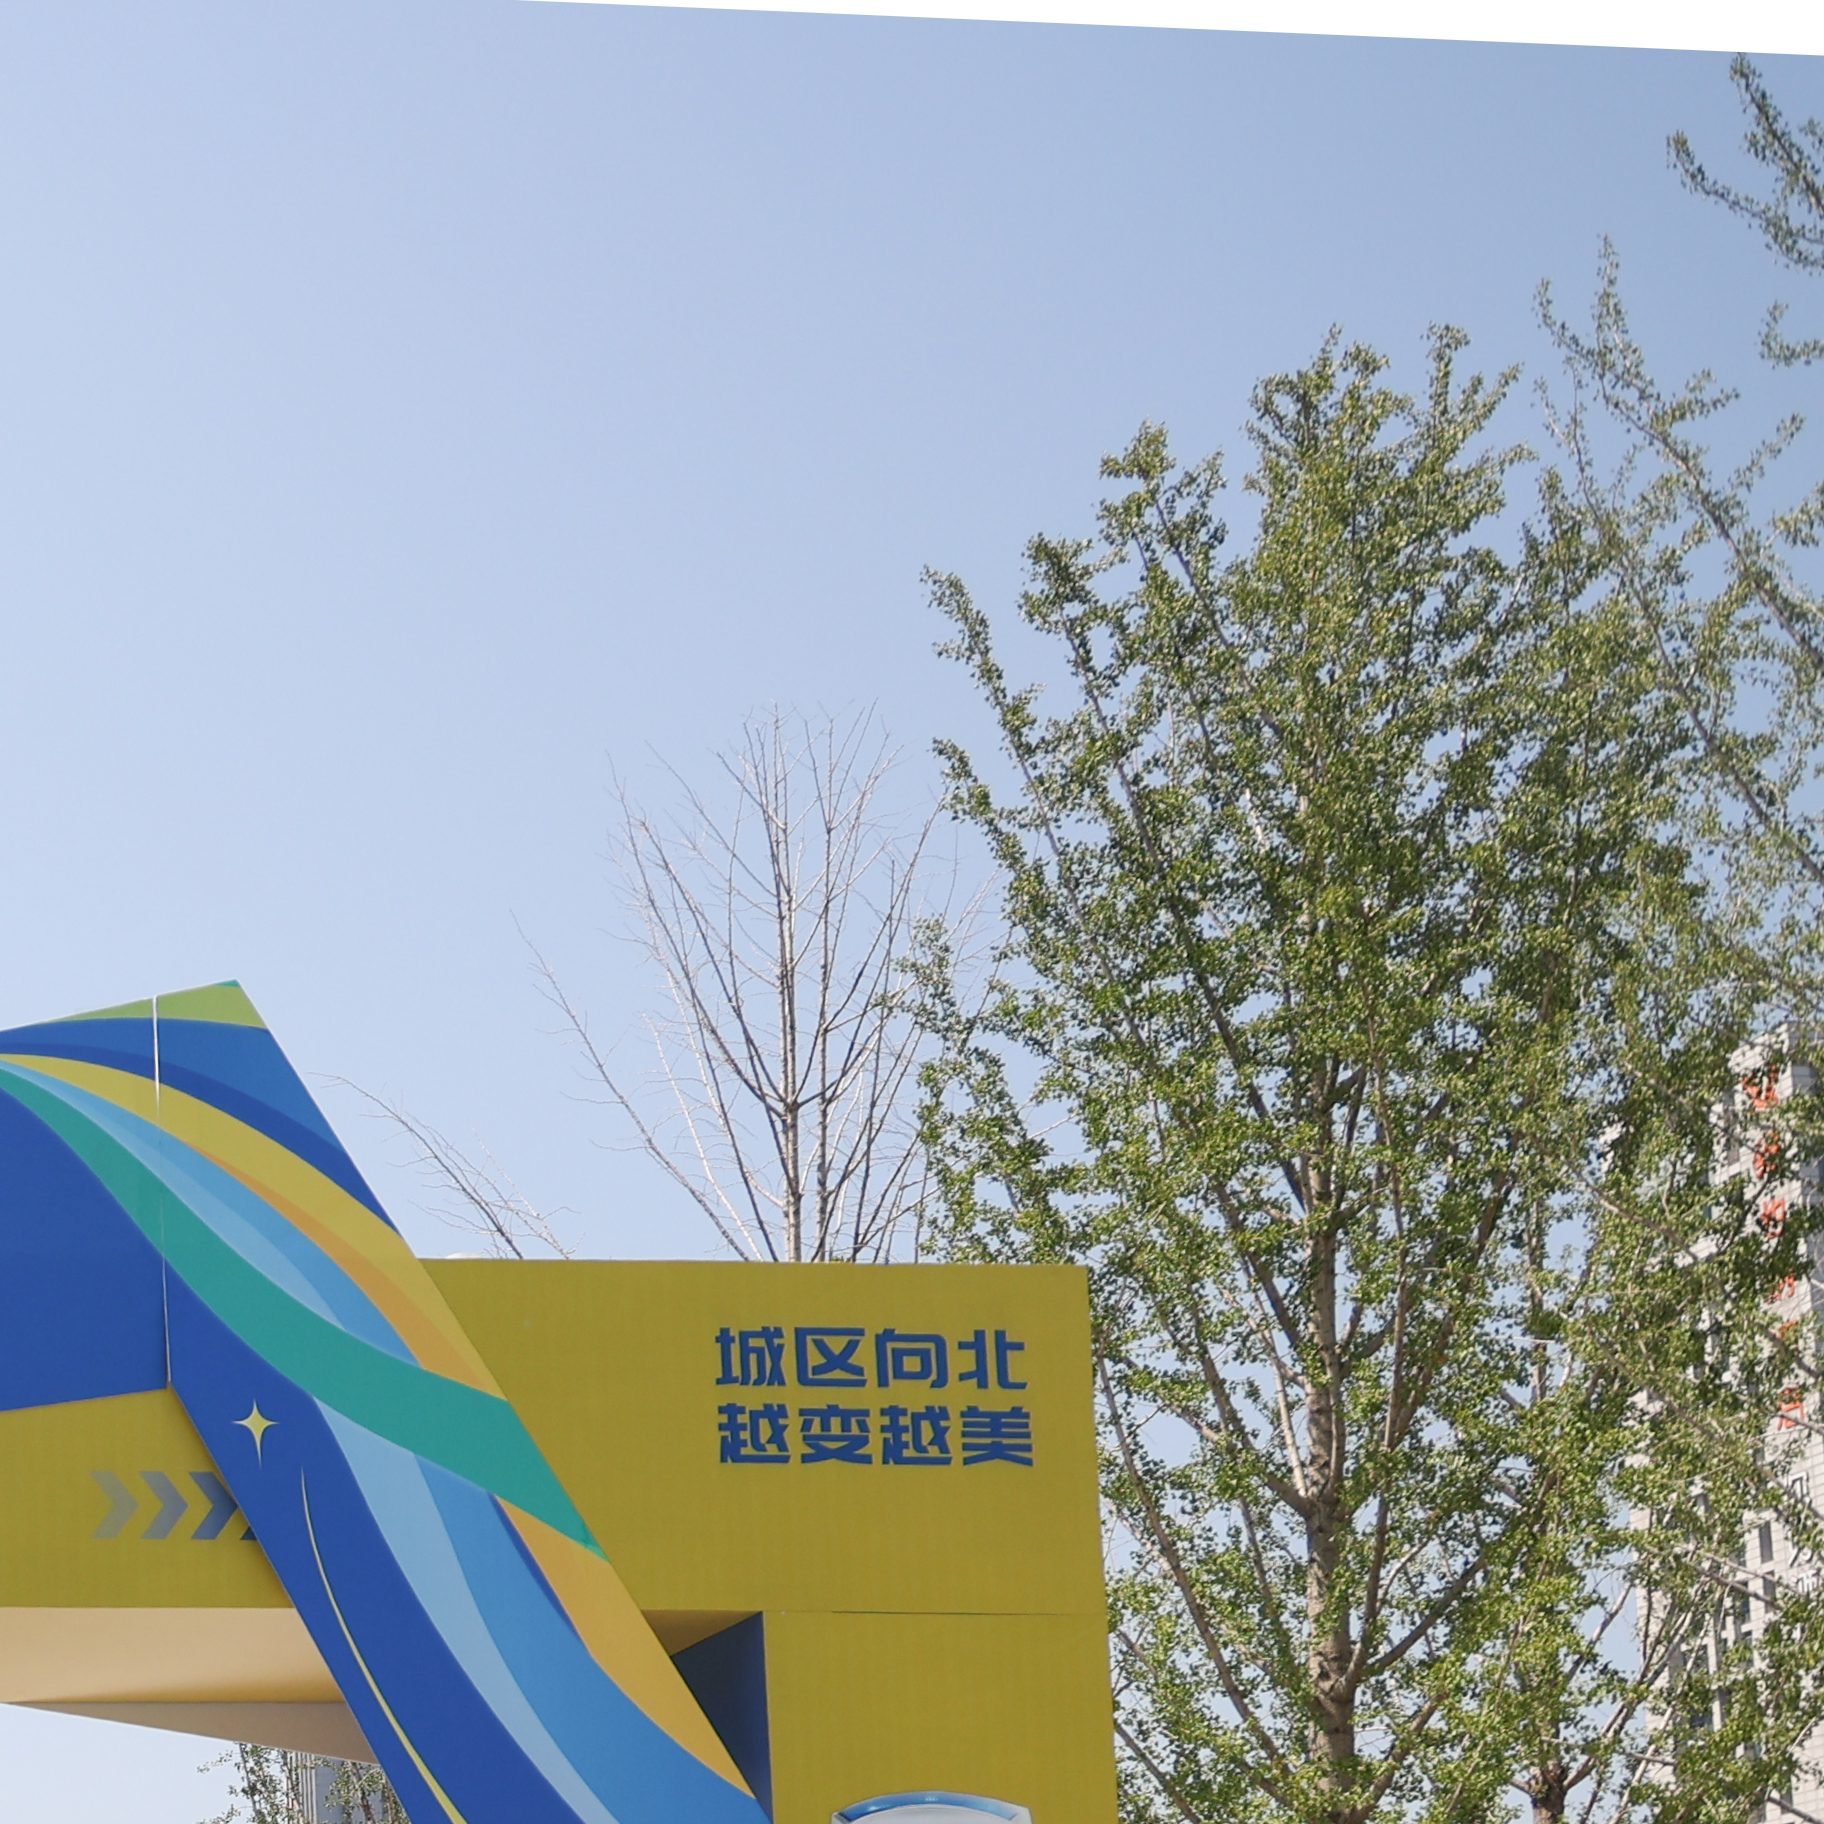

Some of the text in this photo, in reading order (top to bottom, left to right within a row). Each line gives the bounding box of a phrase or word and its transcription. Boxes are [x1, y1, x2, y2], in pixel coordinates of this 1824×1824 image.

[715, 1326, 1028, 1389] 城区向北
[717, 1403, 1034, 1467] 越变越美
